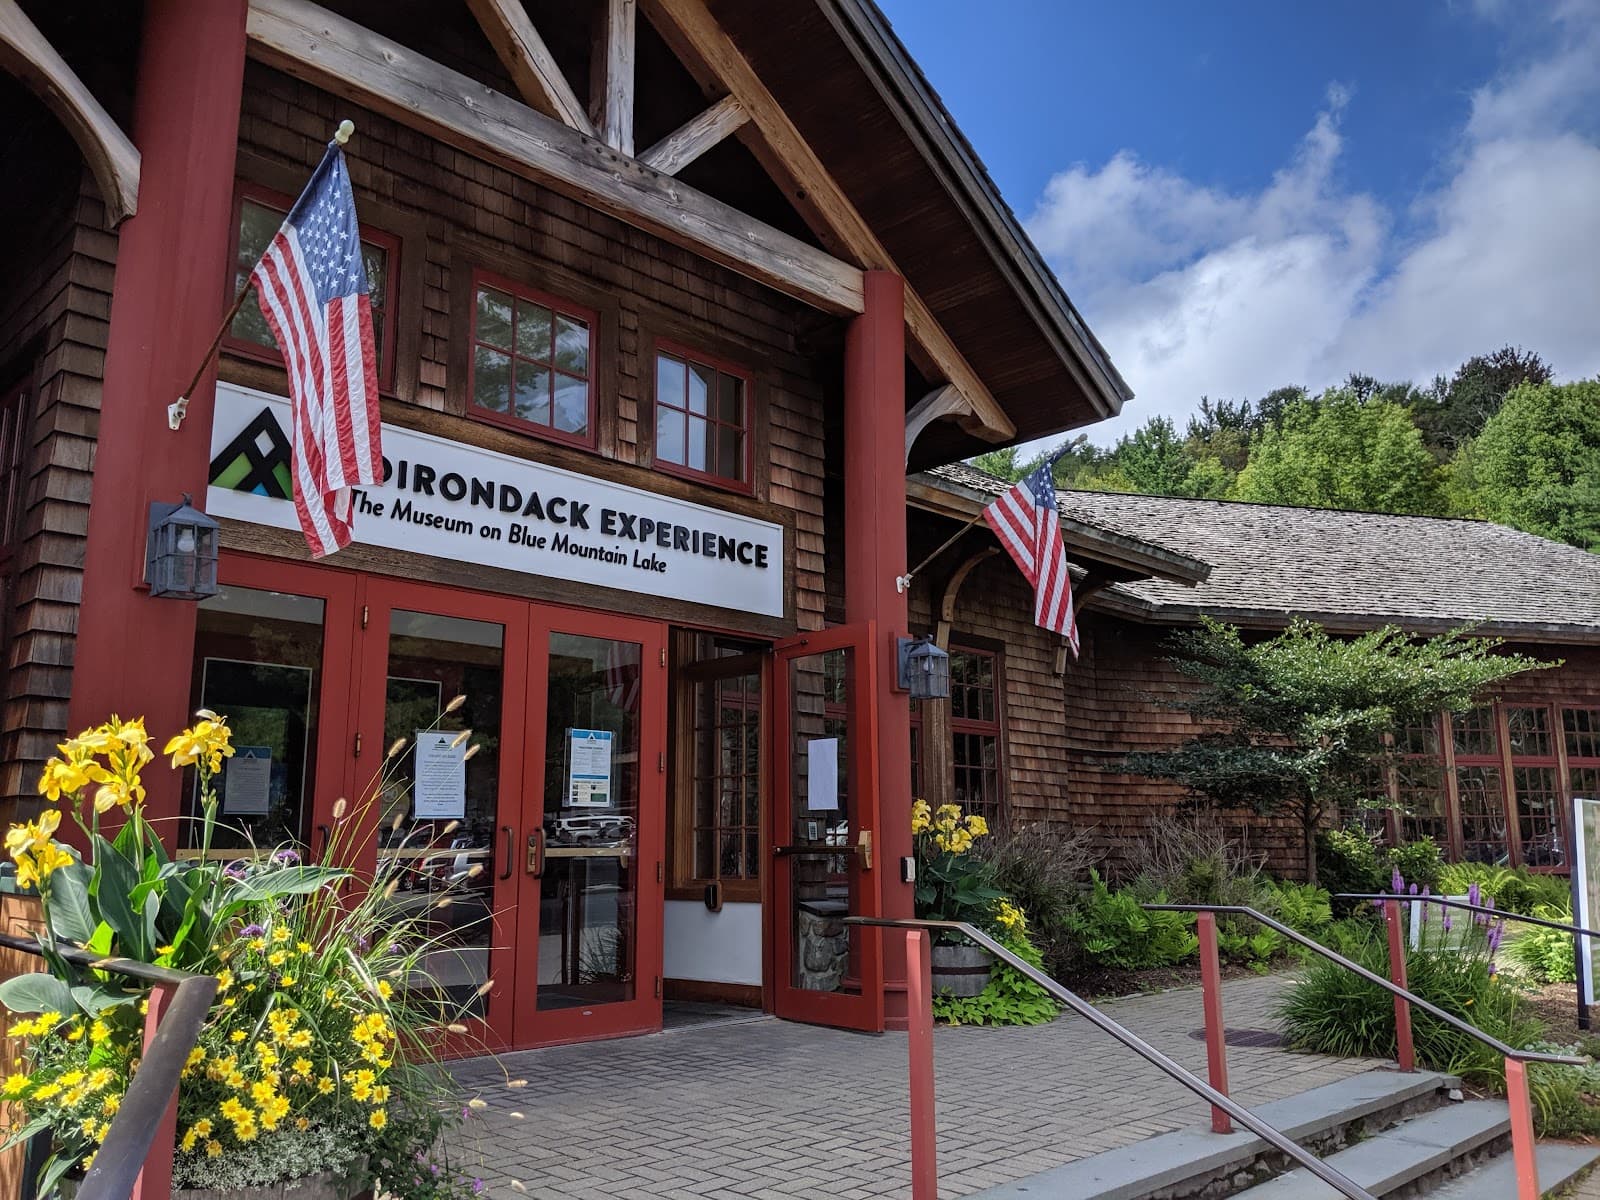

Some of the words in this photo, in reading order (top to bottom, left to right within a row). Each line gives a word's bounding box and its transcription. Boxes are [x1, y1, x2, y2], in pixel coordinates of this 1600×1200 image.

[352, 488, 384, 516] The
[390, 498, 473, 535] Museum
[479, 525, 501, 540] on
[508, 523, 547, 549] Blue
[551, 532, 628, 566] Mountain
[632, 548, 667, 573] Lake
[382, 456, 590, 530] IRONDACK
[600, 508, 768, 568] EXPERIENCE
